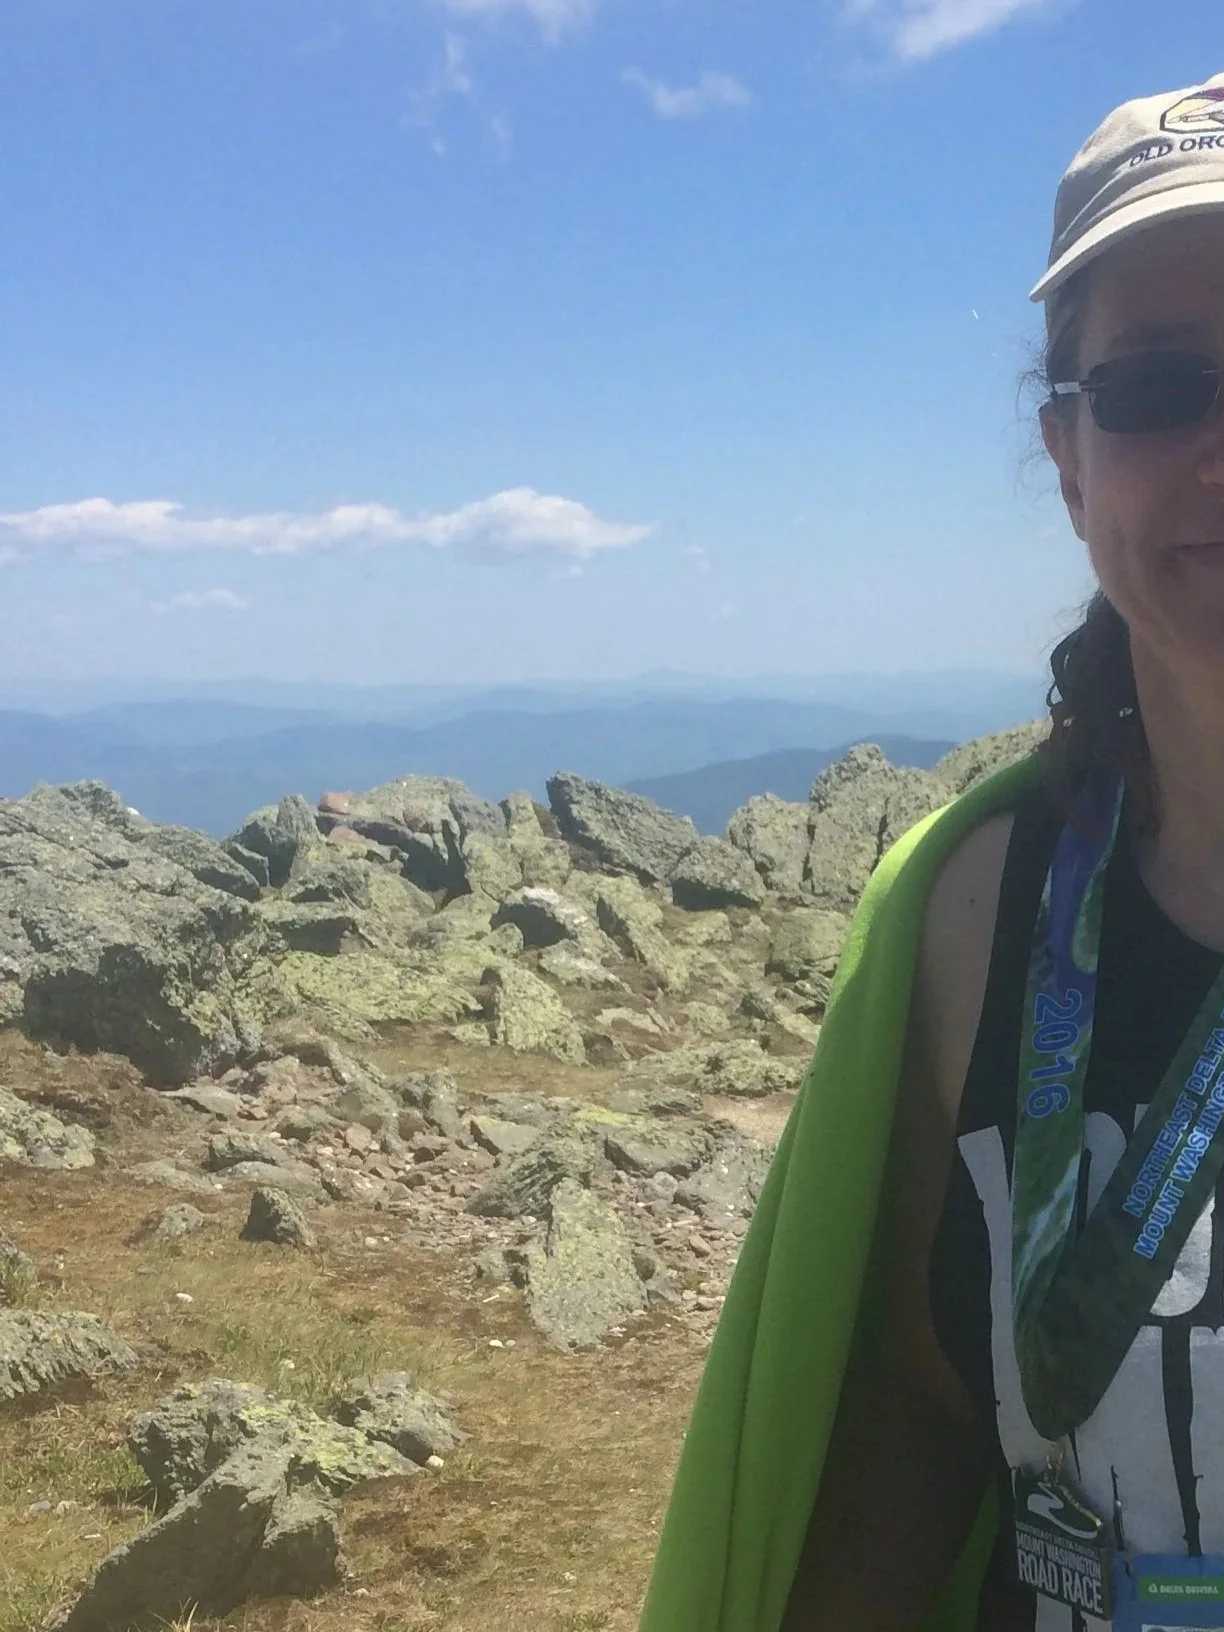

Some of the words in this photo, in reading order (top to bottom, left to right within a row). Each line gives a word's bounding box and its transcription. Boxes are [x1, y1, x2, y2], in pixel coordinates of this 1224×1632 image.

[1128, 142, 1174, 169] OLD
[1025, 987, 1083, 1119] 2016
[1122, 1091, 1199, 1219] NORTHEAST
[1132, 1172, 1186, 1261] MOUNT
[1017, 1548, 1060, 1596] ROAD
[1062, 1566, 1105, 1615] RACE
